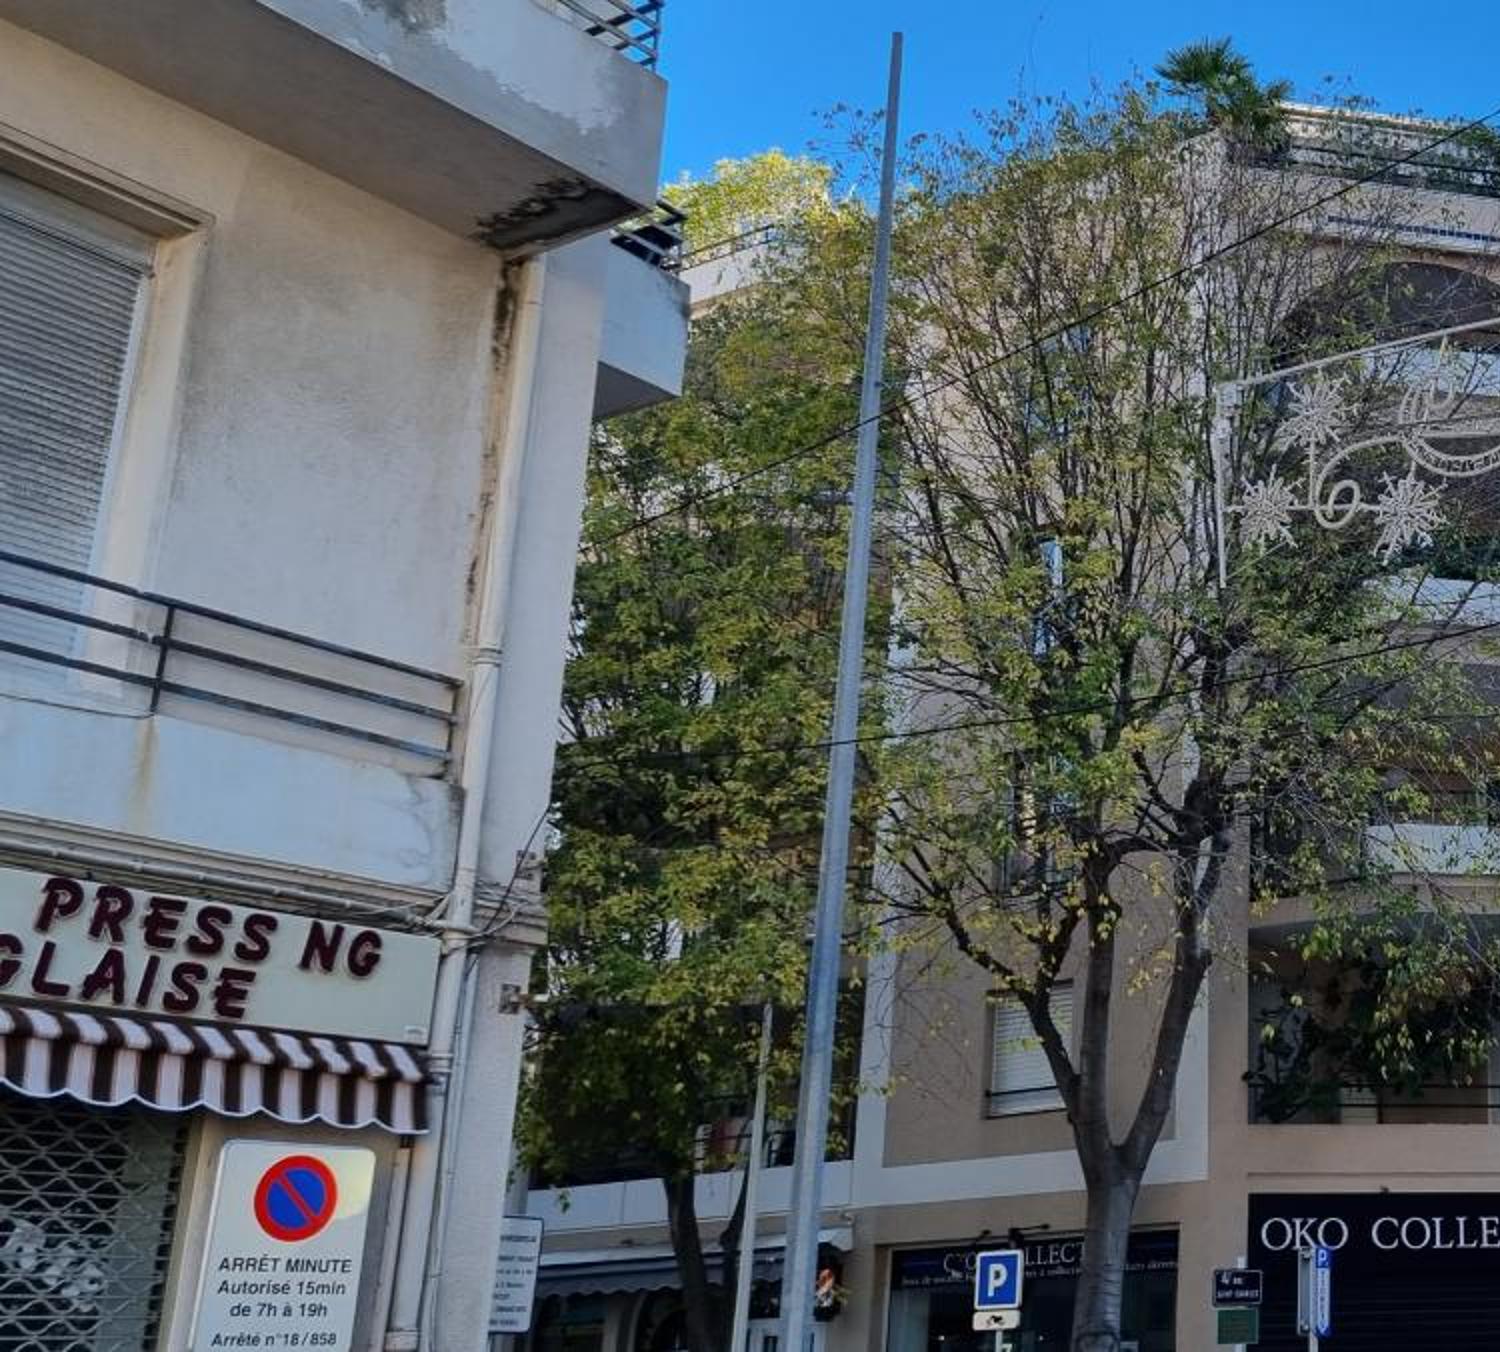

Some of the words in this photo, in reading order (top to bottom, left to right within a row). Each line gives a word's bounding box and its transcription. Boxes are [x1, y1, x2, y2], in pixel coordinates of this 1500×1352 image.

[1261, 1217, 1349, 1251] OKO
[218, 1253, 280, 1273] ARRÊT
[285, 1258, 353, 1273] MINUTE
[217, 1279, 291, 1295] Autorisé
[297, 1281, 347, 1295] 15min
[987, 1263, 1008, 1297] P
[229, 1302, 251, 1317] de
[256, 1302, 277, 1317] 7h
[282, 1302, 293, 1317] à
[300, 1302, 328, 1317] 19h
[211, 1332, 261, 1347] Arrêté
